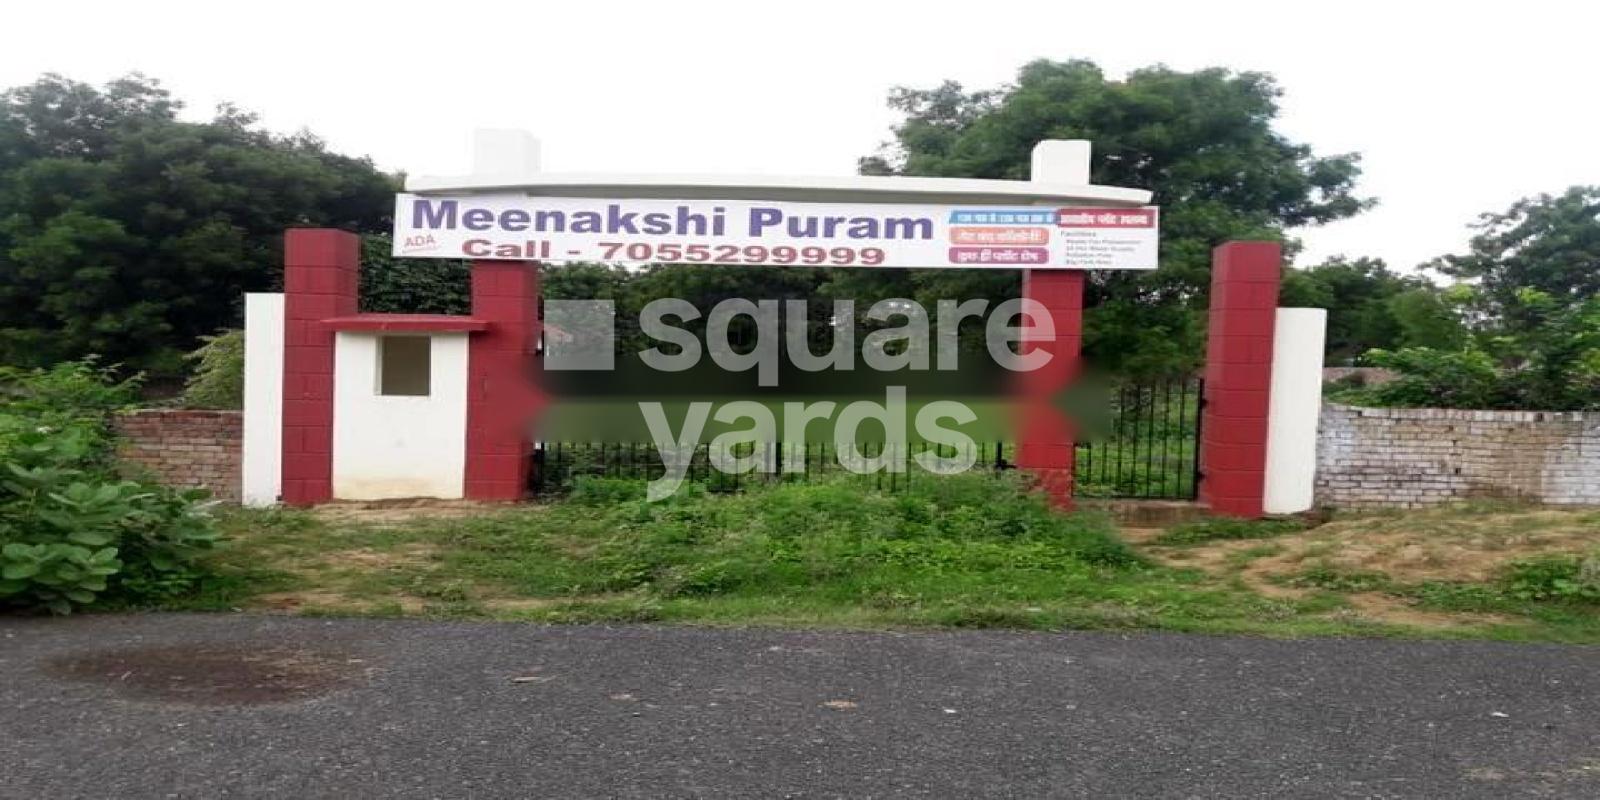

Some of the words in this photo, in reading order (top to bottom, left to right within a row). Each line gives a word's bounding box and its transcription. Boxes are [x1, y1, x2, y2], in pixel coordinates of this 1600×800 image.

[412, 200, 725, 236] Meenakshi
[748, 207, 934, 240] Puram
[461, 239, 550, 259] Call
[597, 242, 886, 266] 7055299999
